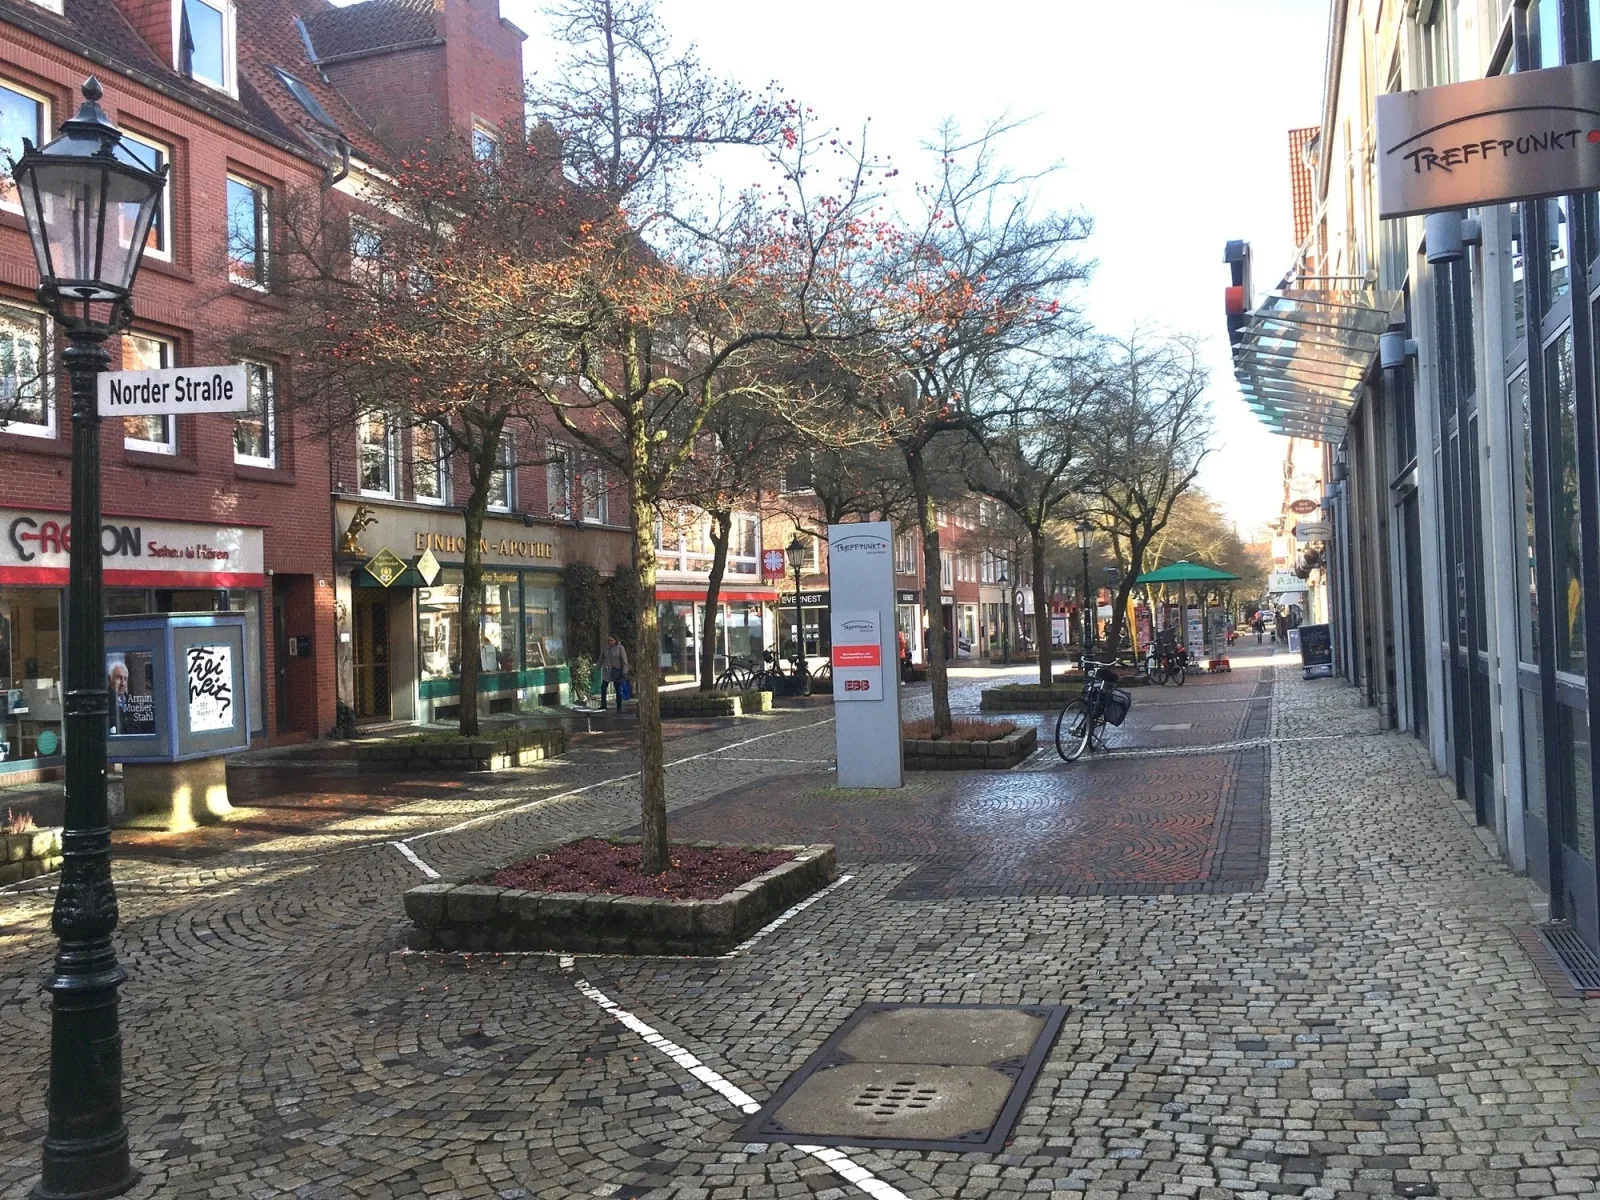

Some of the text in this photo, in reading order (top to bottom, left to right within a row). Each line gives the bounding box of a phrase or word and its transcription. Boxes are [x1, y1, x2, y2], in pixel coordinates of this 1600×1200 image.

[1403, 129, 1583, 174] TREFFPUNKT
[109, 374, 234, 405] Norder Straße
[415, 532, 553, 558] EINHON-APOTHE
[834, 543, 881, 553] TREFFPUNKT
[187, 647, 225, 682] Frei
[844, 680, 870, 691] EBB
[127, 693, 153, 703] Armin
[123, 703, 155, 713] Mueller-
[133, 712, 154, 722] Stahl
